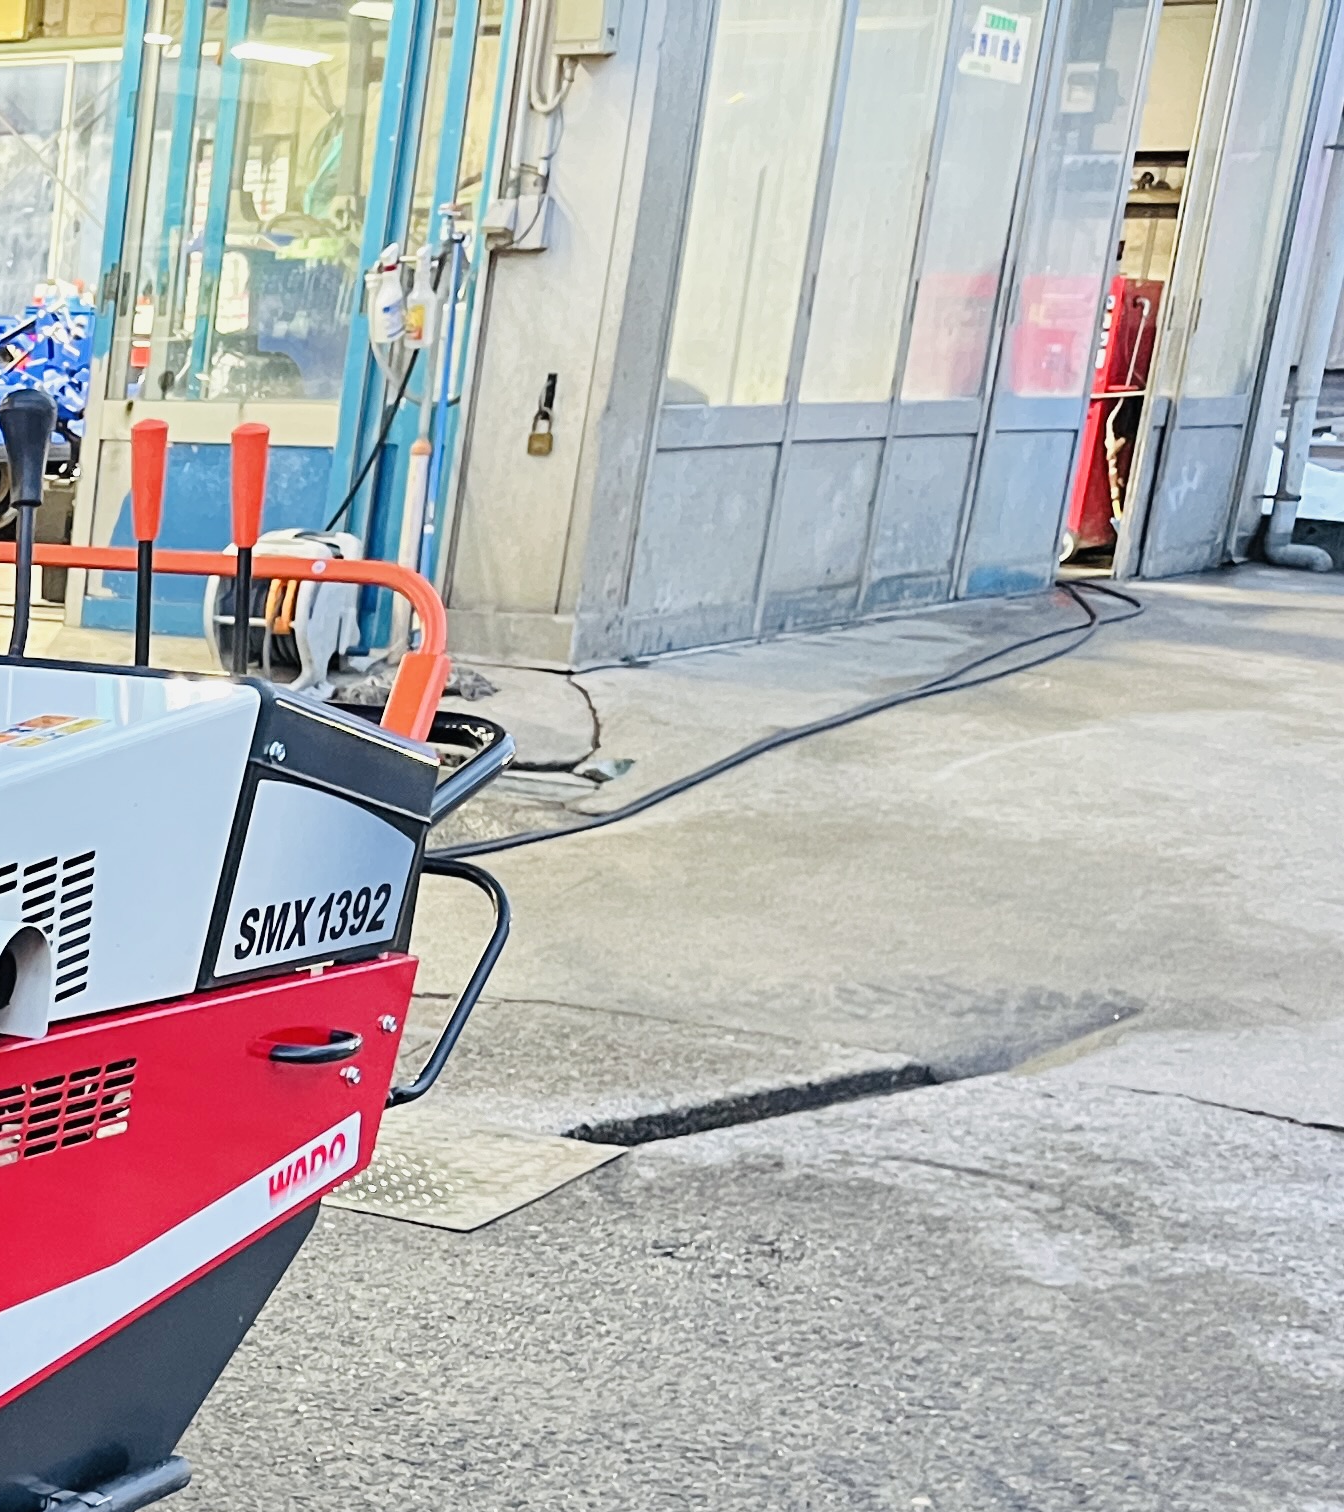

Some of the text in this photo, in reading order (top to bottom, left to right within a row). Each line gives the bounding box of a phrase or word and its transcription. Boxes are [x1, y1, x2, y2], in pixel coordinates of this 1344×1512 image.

[234, 883, 392, 960] SMX 1392
[268, 1132, 346, 1208] WADO
